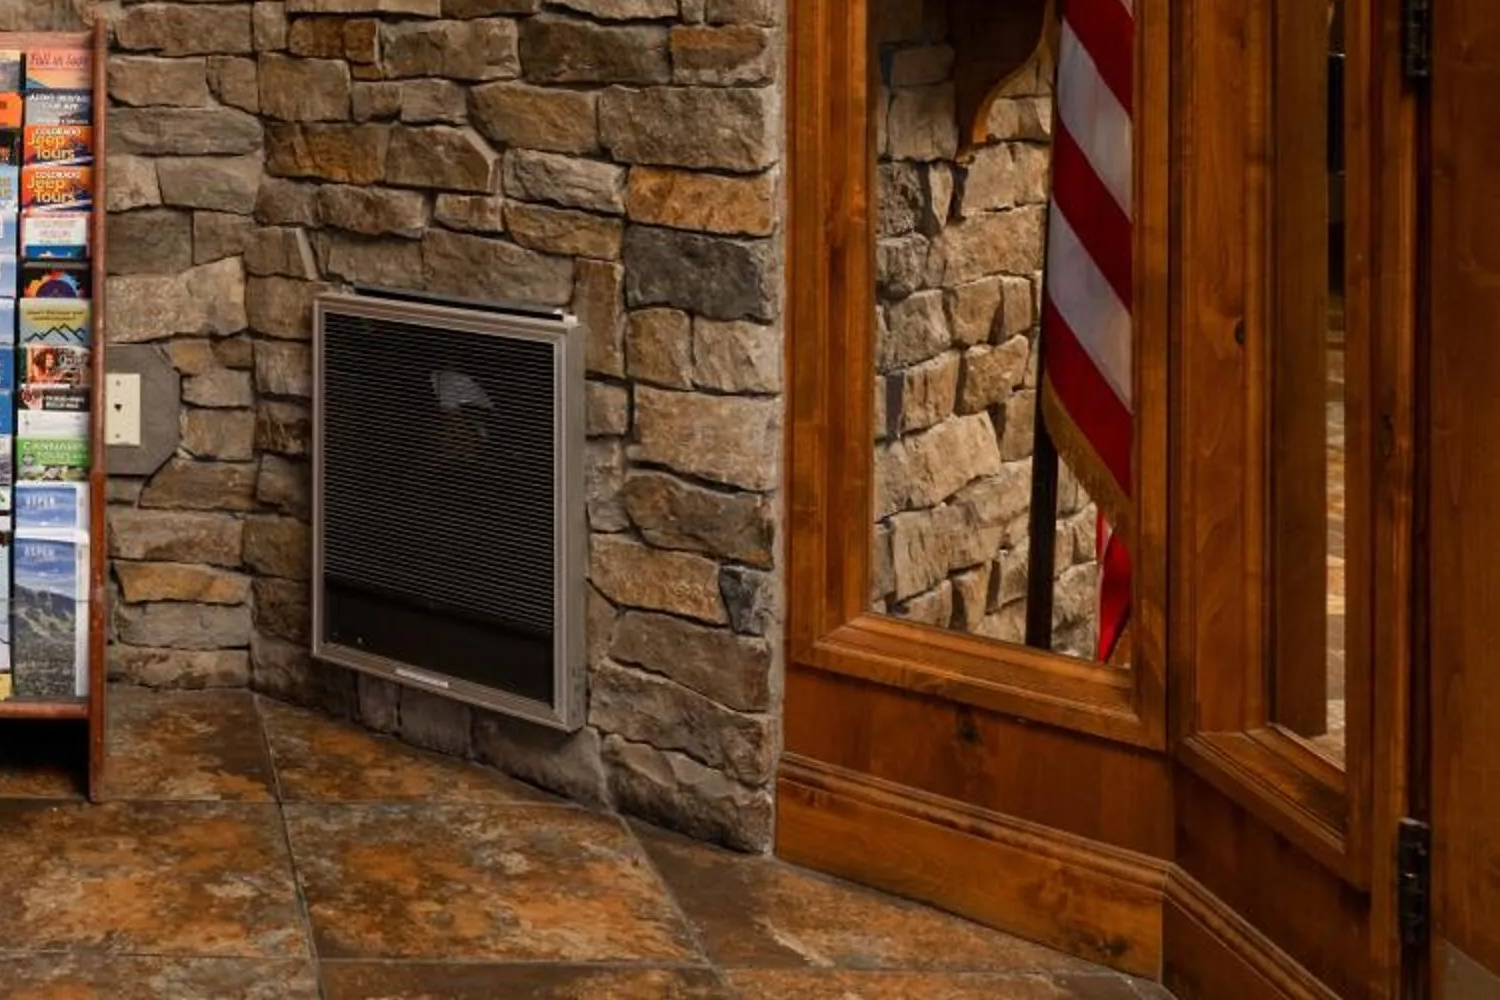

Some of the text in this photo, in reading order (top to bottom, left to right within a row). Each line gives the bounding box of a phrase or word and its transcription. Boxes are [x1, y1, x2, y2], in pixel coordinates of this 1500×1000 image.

[27, 133, 66, 150] Jeep
[35, 148, 75, 160] Tours
[27, 176, 67, 193] Jeep
[35, 190, 75, 203] Tours
